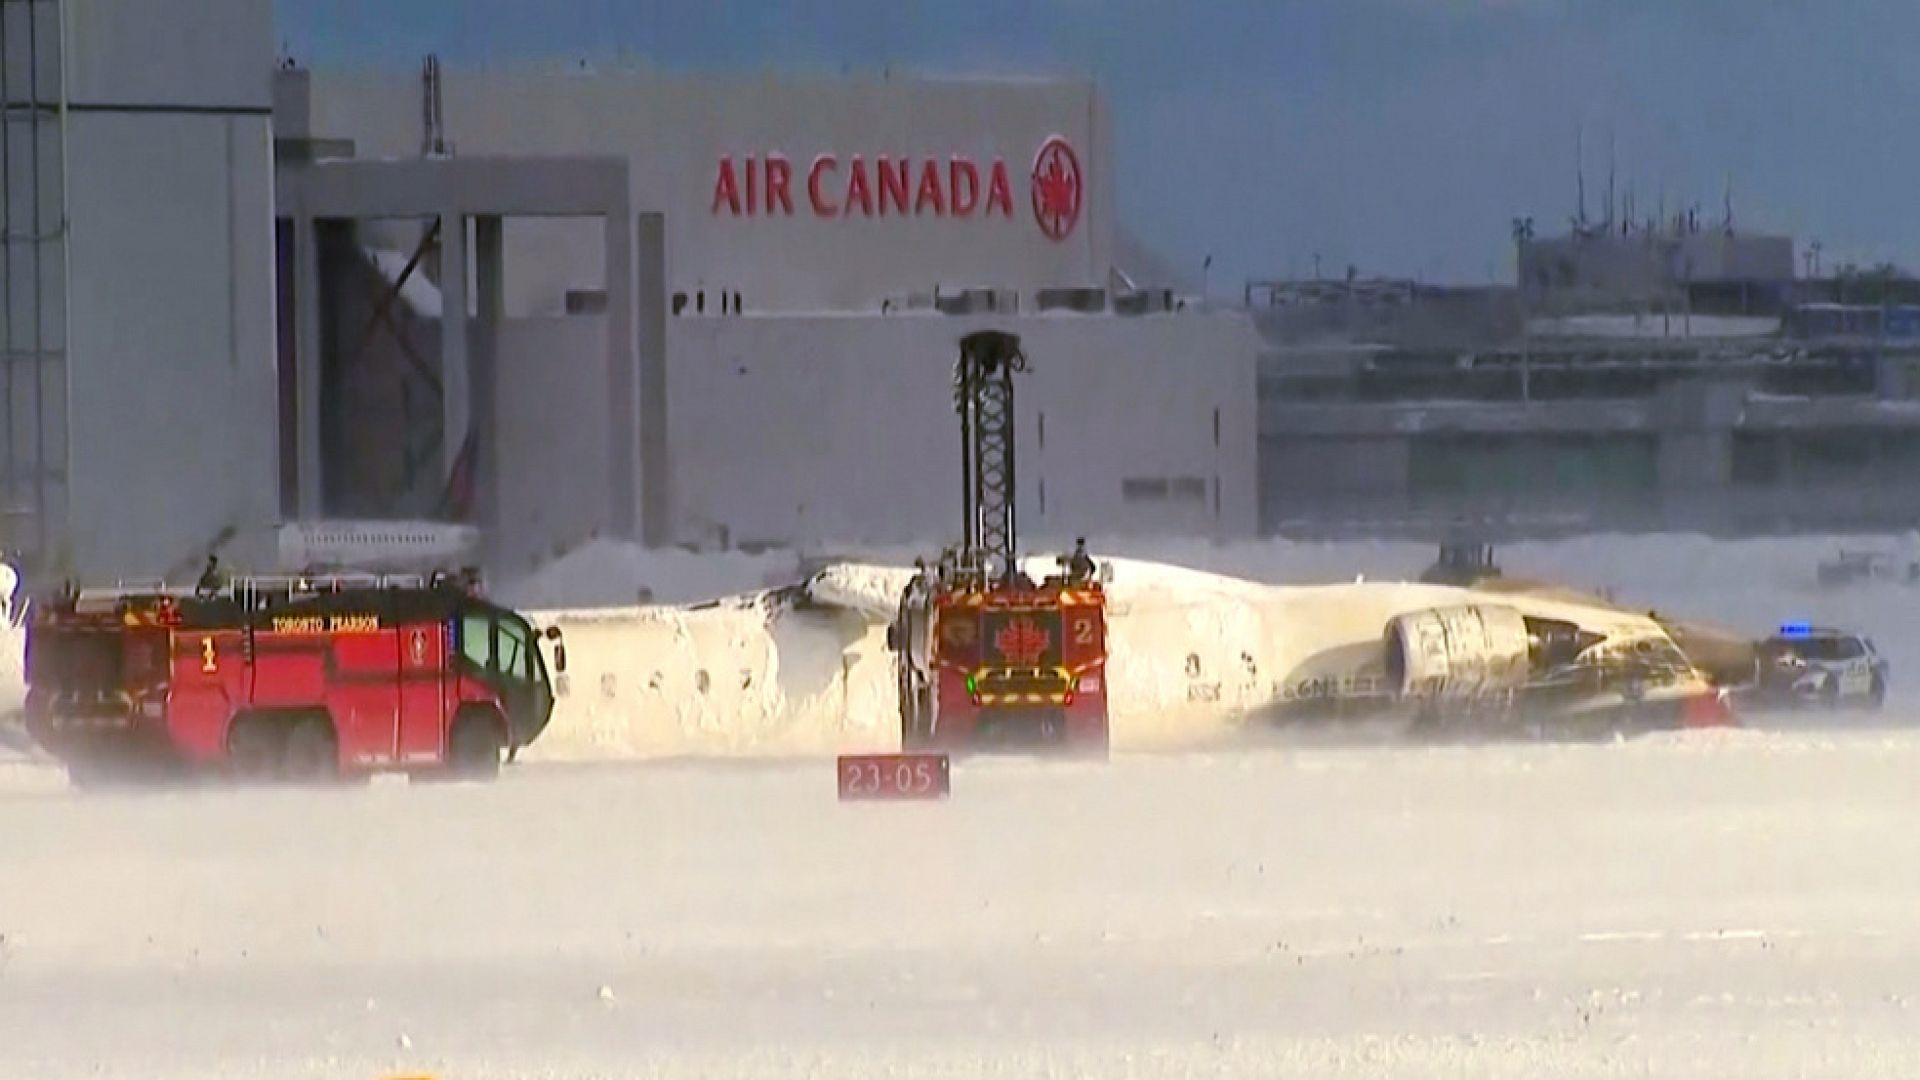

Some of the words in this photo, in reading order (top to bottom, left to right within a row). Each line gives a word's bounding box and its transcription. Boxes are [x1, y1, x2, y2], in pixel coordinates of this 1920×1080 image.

[712, 153, 794, 217] AIR
[807, 153, 1015, 218] CANADA
[272, 616, 323, 634] TORONTO
[1073, 618, 1093, 644] 2
[847, 763, 932, 792] 23-05
